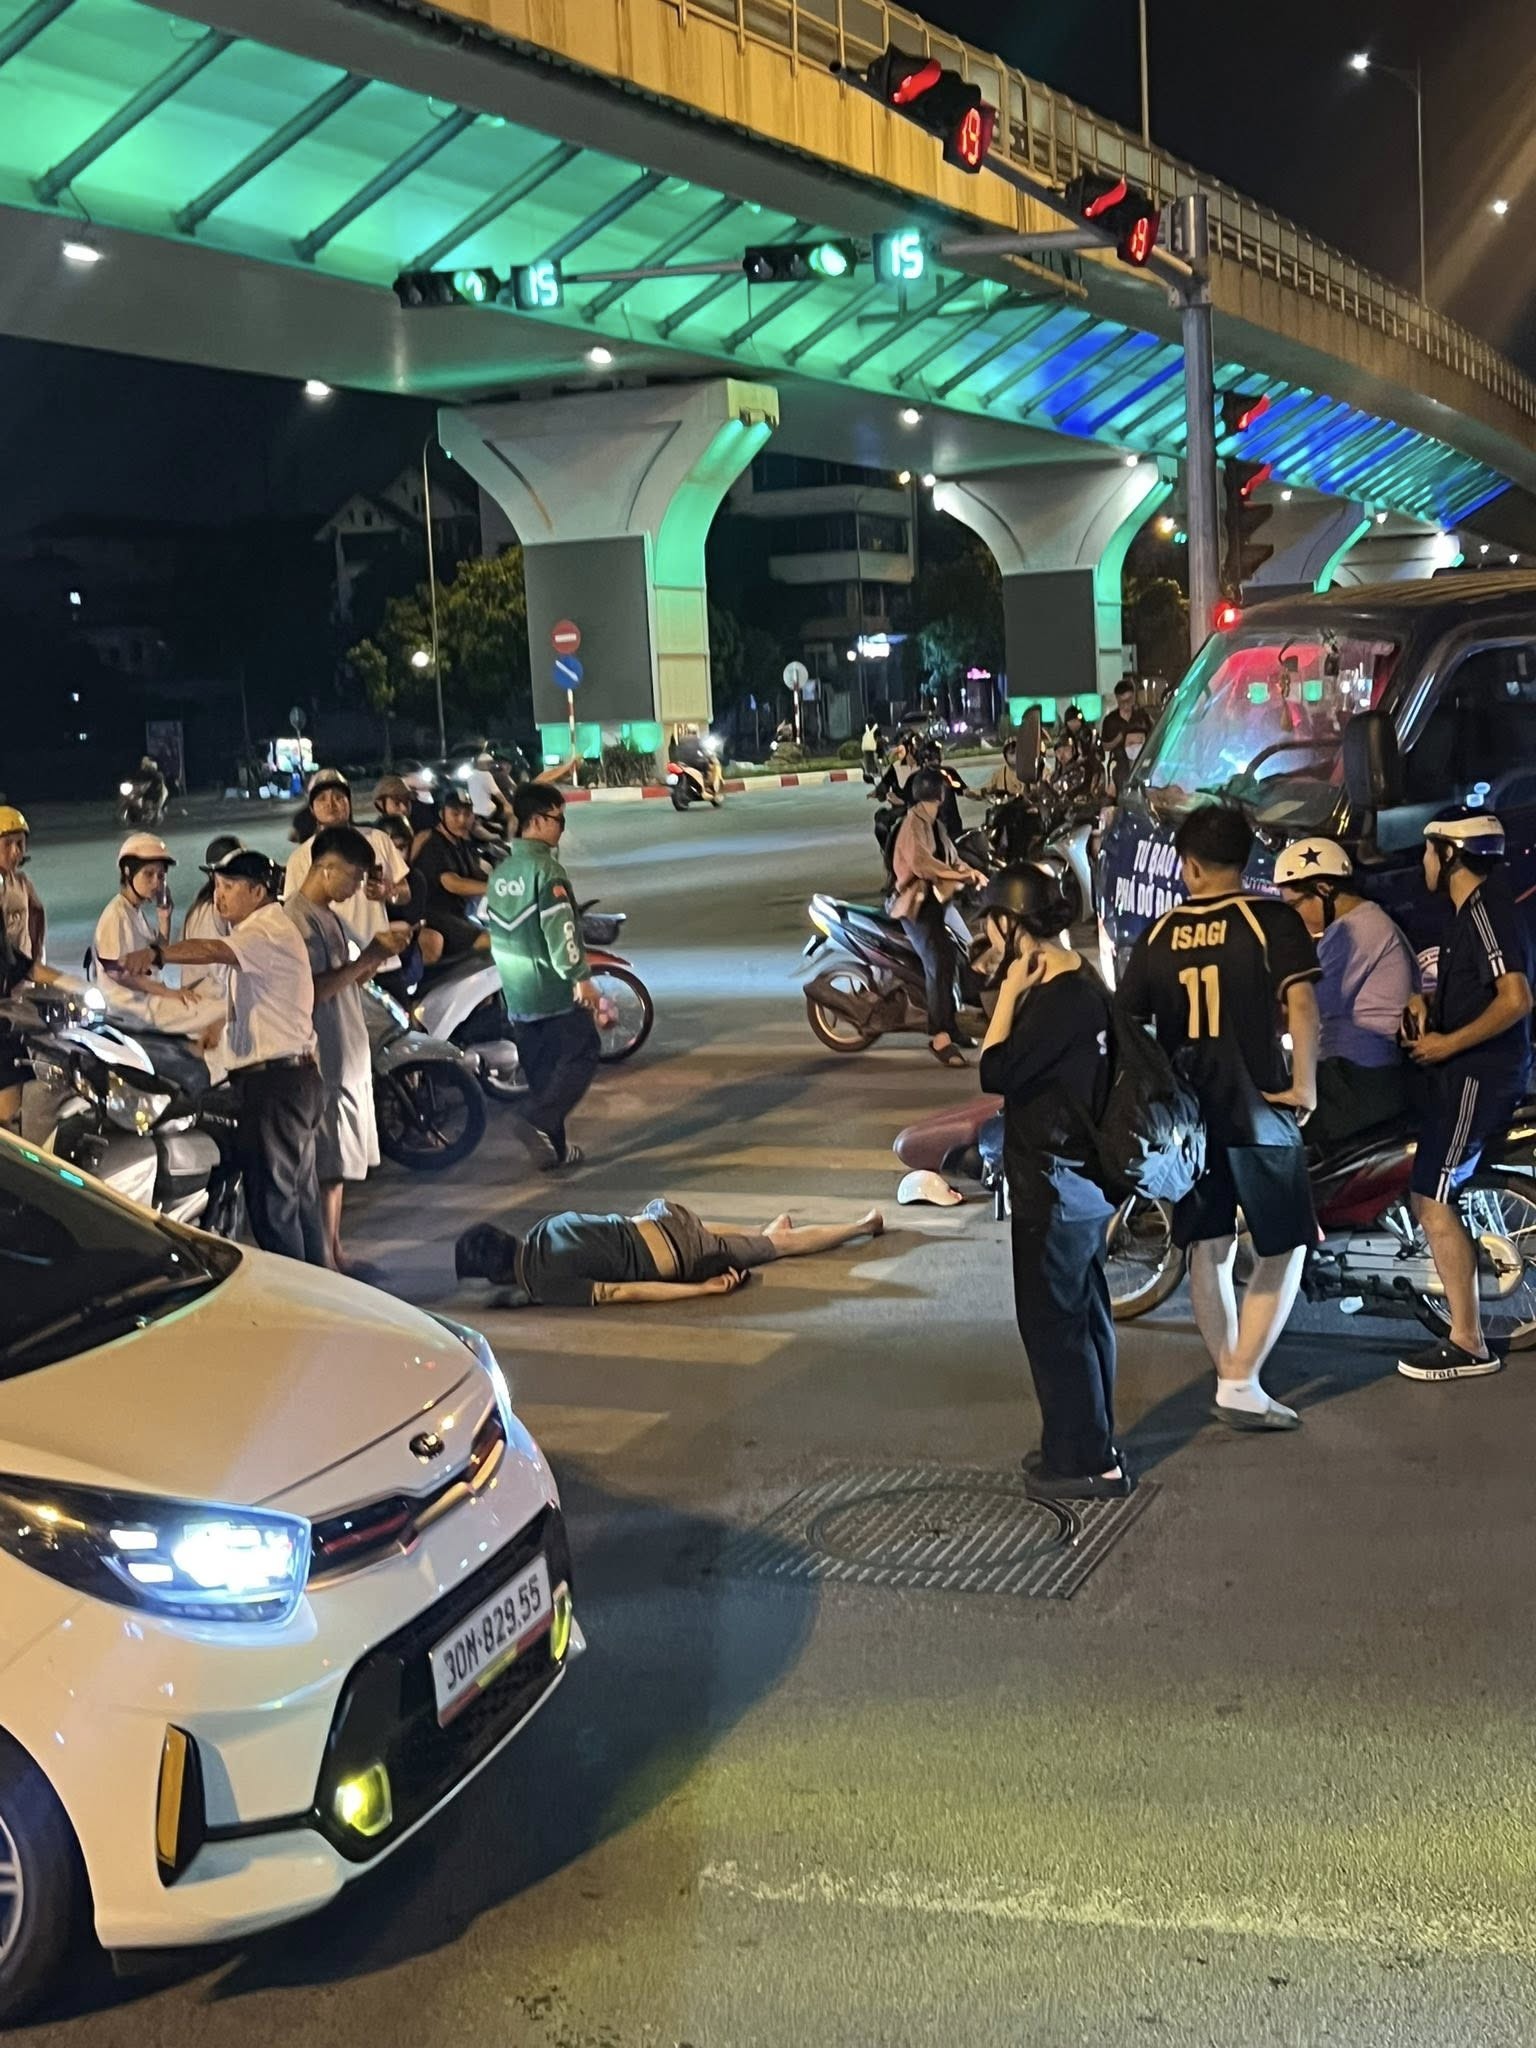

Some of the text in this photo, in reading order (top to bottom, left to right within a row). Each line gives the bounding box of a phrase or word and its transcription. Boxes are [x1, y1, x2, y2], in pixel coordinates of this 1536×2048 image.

[962, 108, 981, 166] 19
[890, 232, 924, 279] 15
[1131, 217, 1149, 261] 19
[529, 262, 559, 306] 15
[1173, 919, 1228, 950] ISAGI
[1178, 964, 1220, 1039] 11
